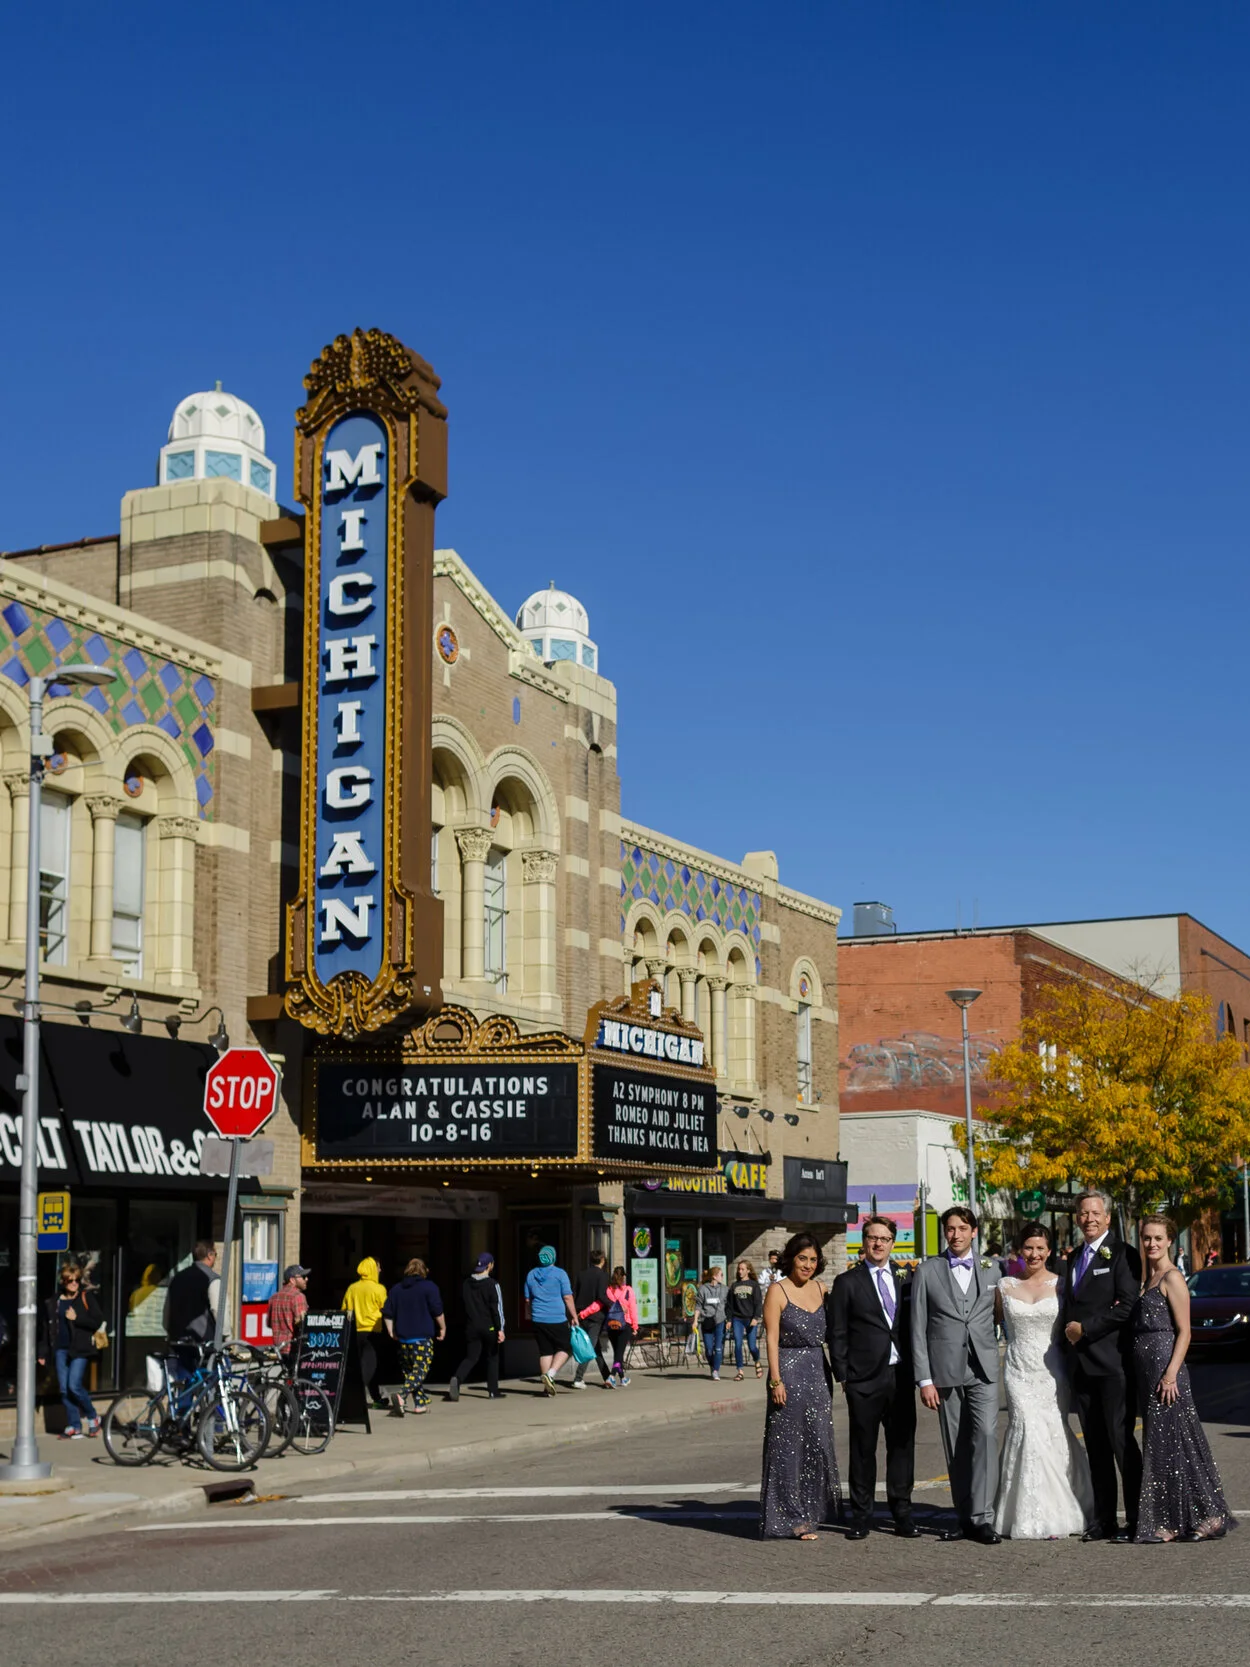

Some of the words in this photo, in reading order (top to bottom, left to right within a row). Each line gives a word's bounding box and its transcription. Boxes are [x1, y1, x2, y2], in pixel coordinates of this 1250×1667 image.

[321, 443, 382, 941] MICHIGAN
[603, 1019, 705, 1065] MICHIGAN
[209, 1076, 272, 1109] STOP
[342, 1077, 548, 1096] CONGRATULATIONS
[612, 1081, 625, 1099] A2
[628, 1083, 679, 1107] SYMPHONY
[682, 1092, 688, 1109] 8
[691, 1094, 704, 1111] PM
[362, 1101, 416, 1119] ALAN
[428, 1101, 440, 1119] &
[451, 1100, 526, 1118] CASSIE
[615, 1104, 648, 1124] ROMEO
[652, 1109, 670, 1127] AND
[673, 1112, 705, 1131] JULIET
[411, 1124, 491, 1142] 10-8-16
[608, 1125, 645, 1146] THANKS
[649, 1130, 680, 1149] MCACA
[683, 1134, 689, 1151] &
[692, 1135, 709, 1152] NEA
[668, 1176, 728, 1194] SMOOTHIE
[731, 1162, 767, 1190] CAFE
[1021, 1201, 1040, 1212] UP
[308, 1333, 340, 1347] BOOK
